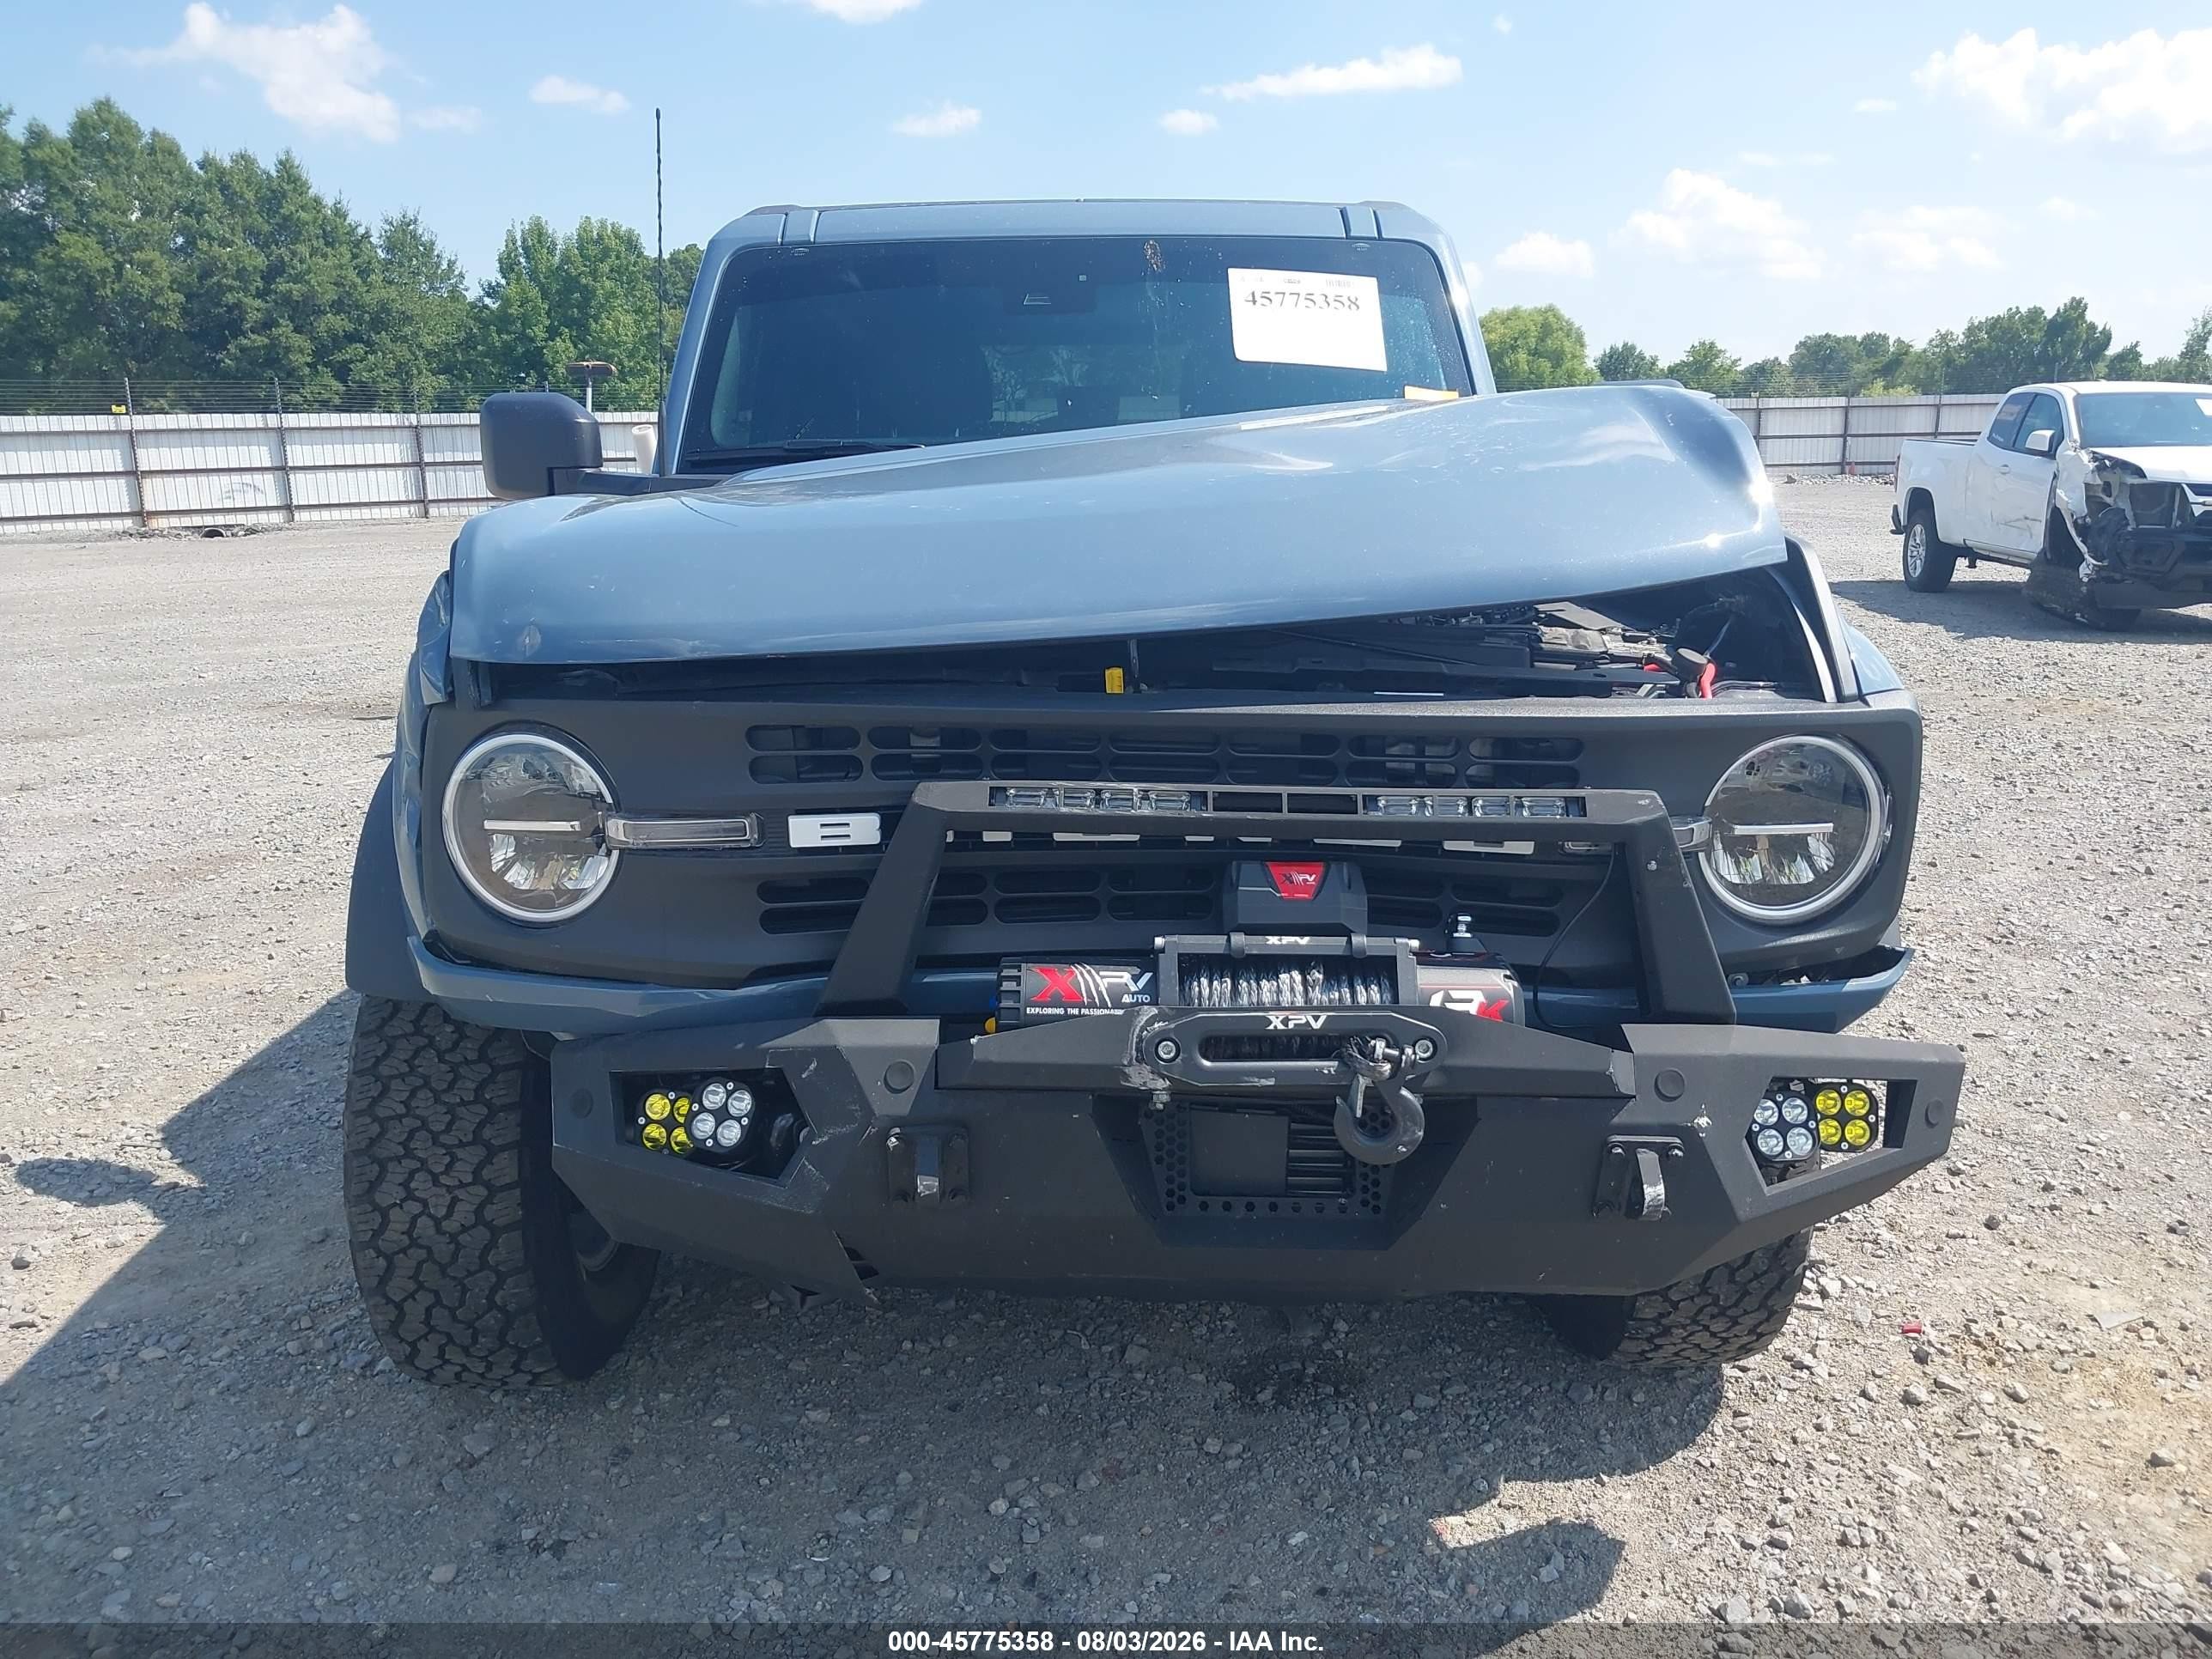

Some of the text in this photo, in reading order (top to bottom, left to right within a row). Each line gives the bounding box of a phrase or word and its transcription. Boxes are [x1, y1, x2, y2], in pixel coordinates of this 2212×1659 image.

[1243, 290, 1360, 311] 45775358
[1266, 935, 1311, 945] XPV
[1121, 994, 1151, 1003] AUTO
[1265, 1015, 1328, 1030] XPV
